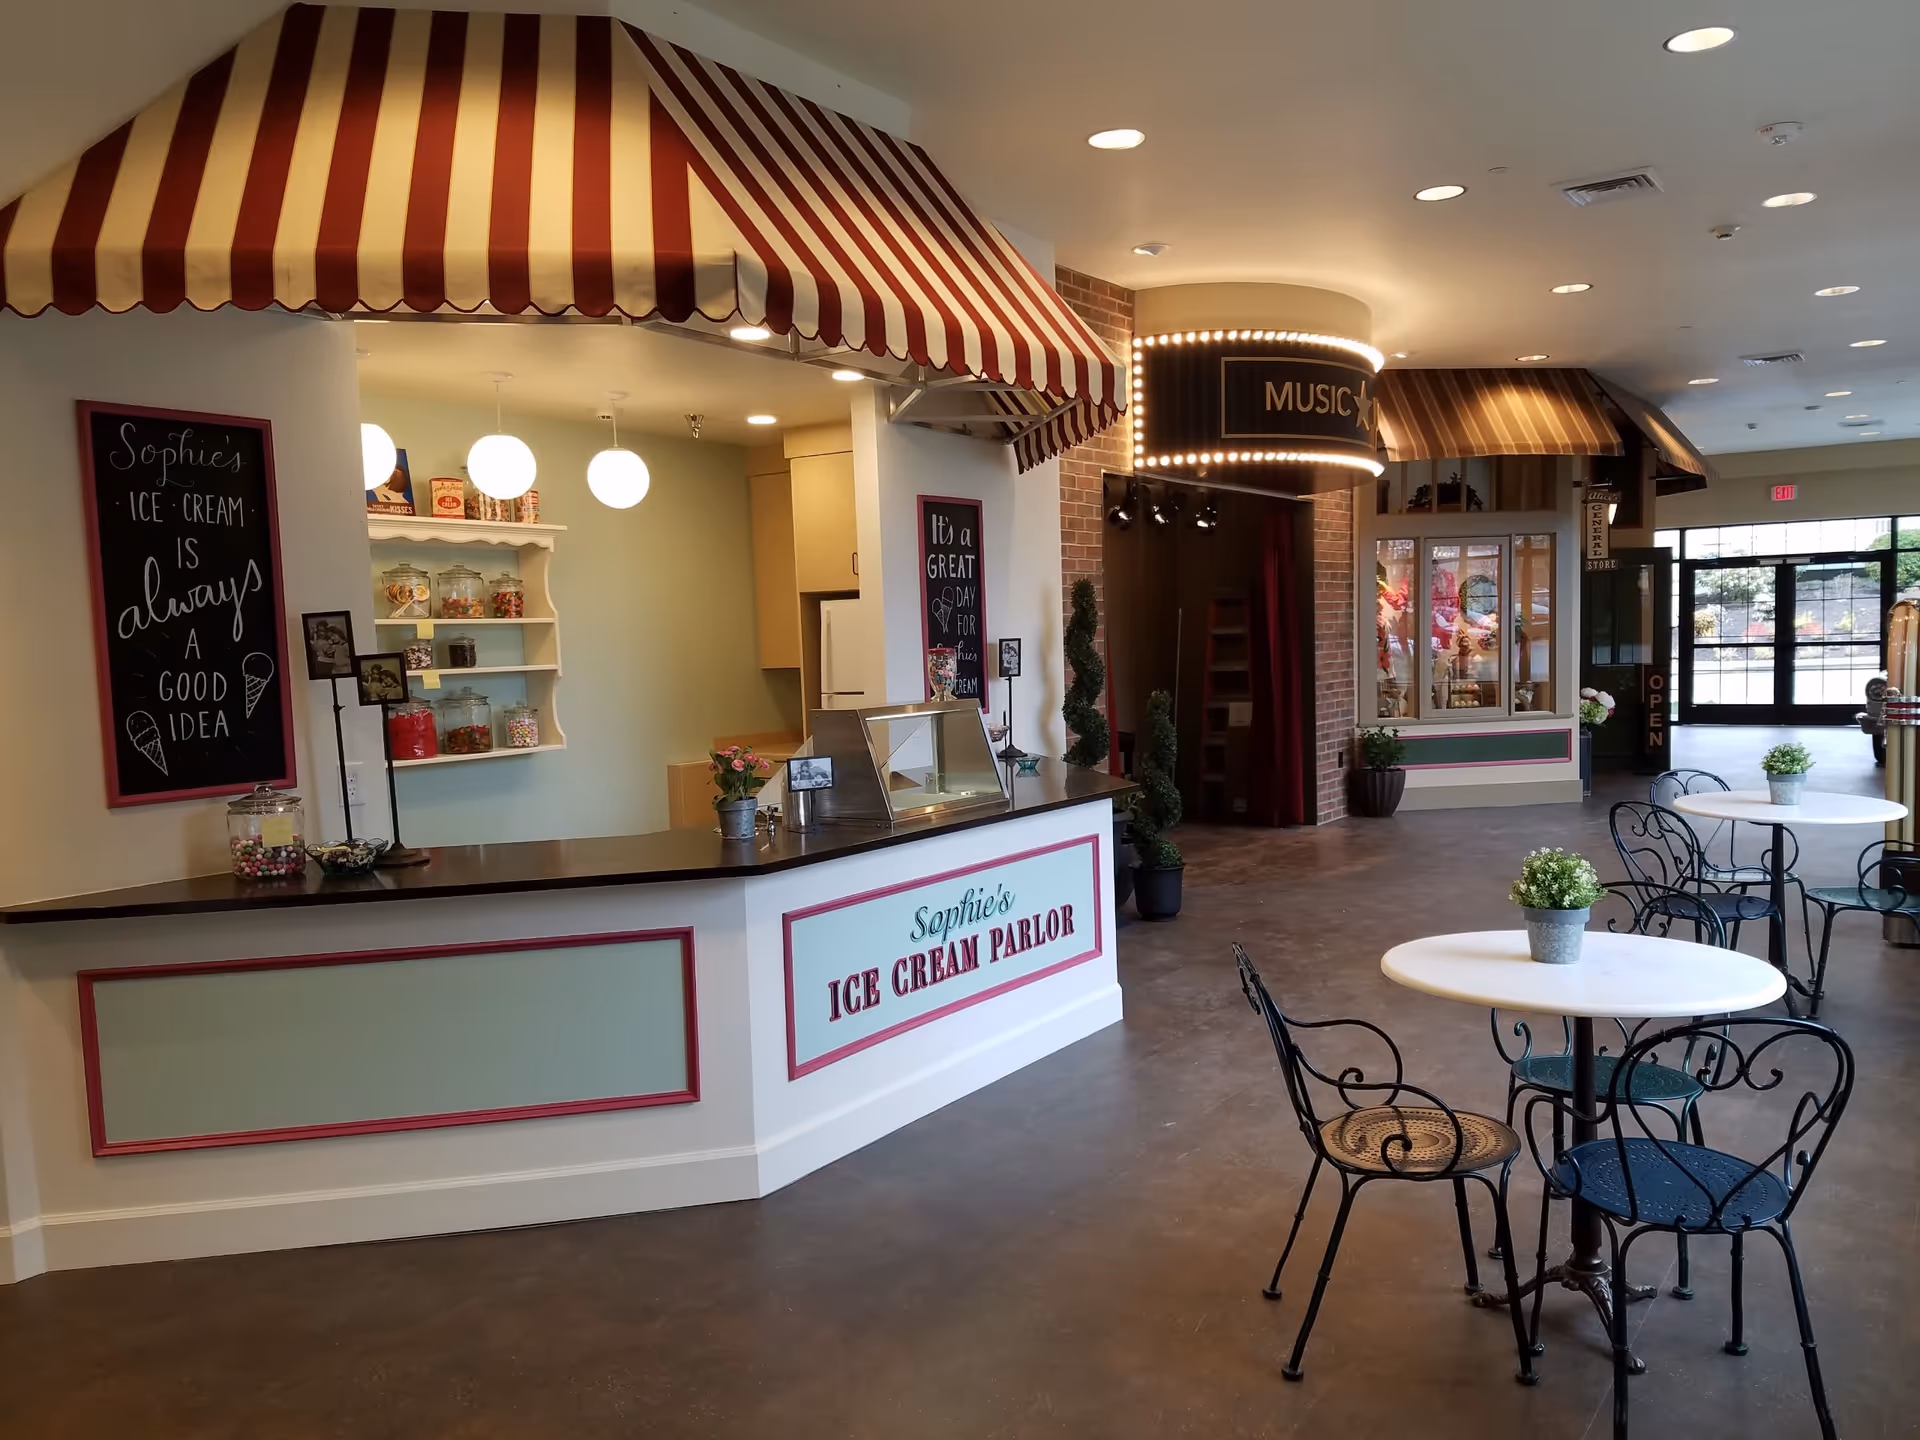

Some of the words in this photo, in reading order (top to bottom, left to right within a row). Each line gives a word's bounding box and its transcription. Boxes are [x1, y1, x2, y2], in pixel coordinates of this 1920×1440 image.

[1265, 381, 1352, 417] MUSIC
[110, 422, 246, 487] Sophie's
[129, 491, 164, 523] ICE
[182, 493, 245, 527] CREAM
[1775, 486, 1795, 500] EXIT
[390, 505, 413, 514] KISSES
[931, 513, 954, 545] It's
[960, 526, 973, 547] a
[1591, 504, 1602, 557] GENERAL
[177, 537, 199, 569] IS
[927, 553, 976, 579] GREAT
[1588, 560, 1616, 570] STORE
[117, 556, 263, 642] always
[956, 586, 976, 608] DAY
[957, 614, 976, 636] FOR
[184, 628, 201, 660] A
[159, 671, 228, 702] GOOD
[954, 677, 978, 695] CREAM
[168, 710, 230, 742] IDEA
[1649, 675, 1664, 746] OPEN
[910, 883, 1016, 944] Sophie's
[828, 967, 881, 1022] ICE
[891, 934, 980, 997] CREAM
[989, 904, 1075, 964] PARLOR
